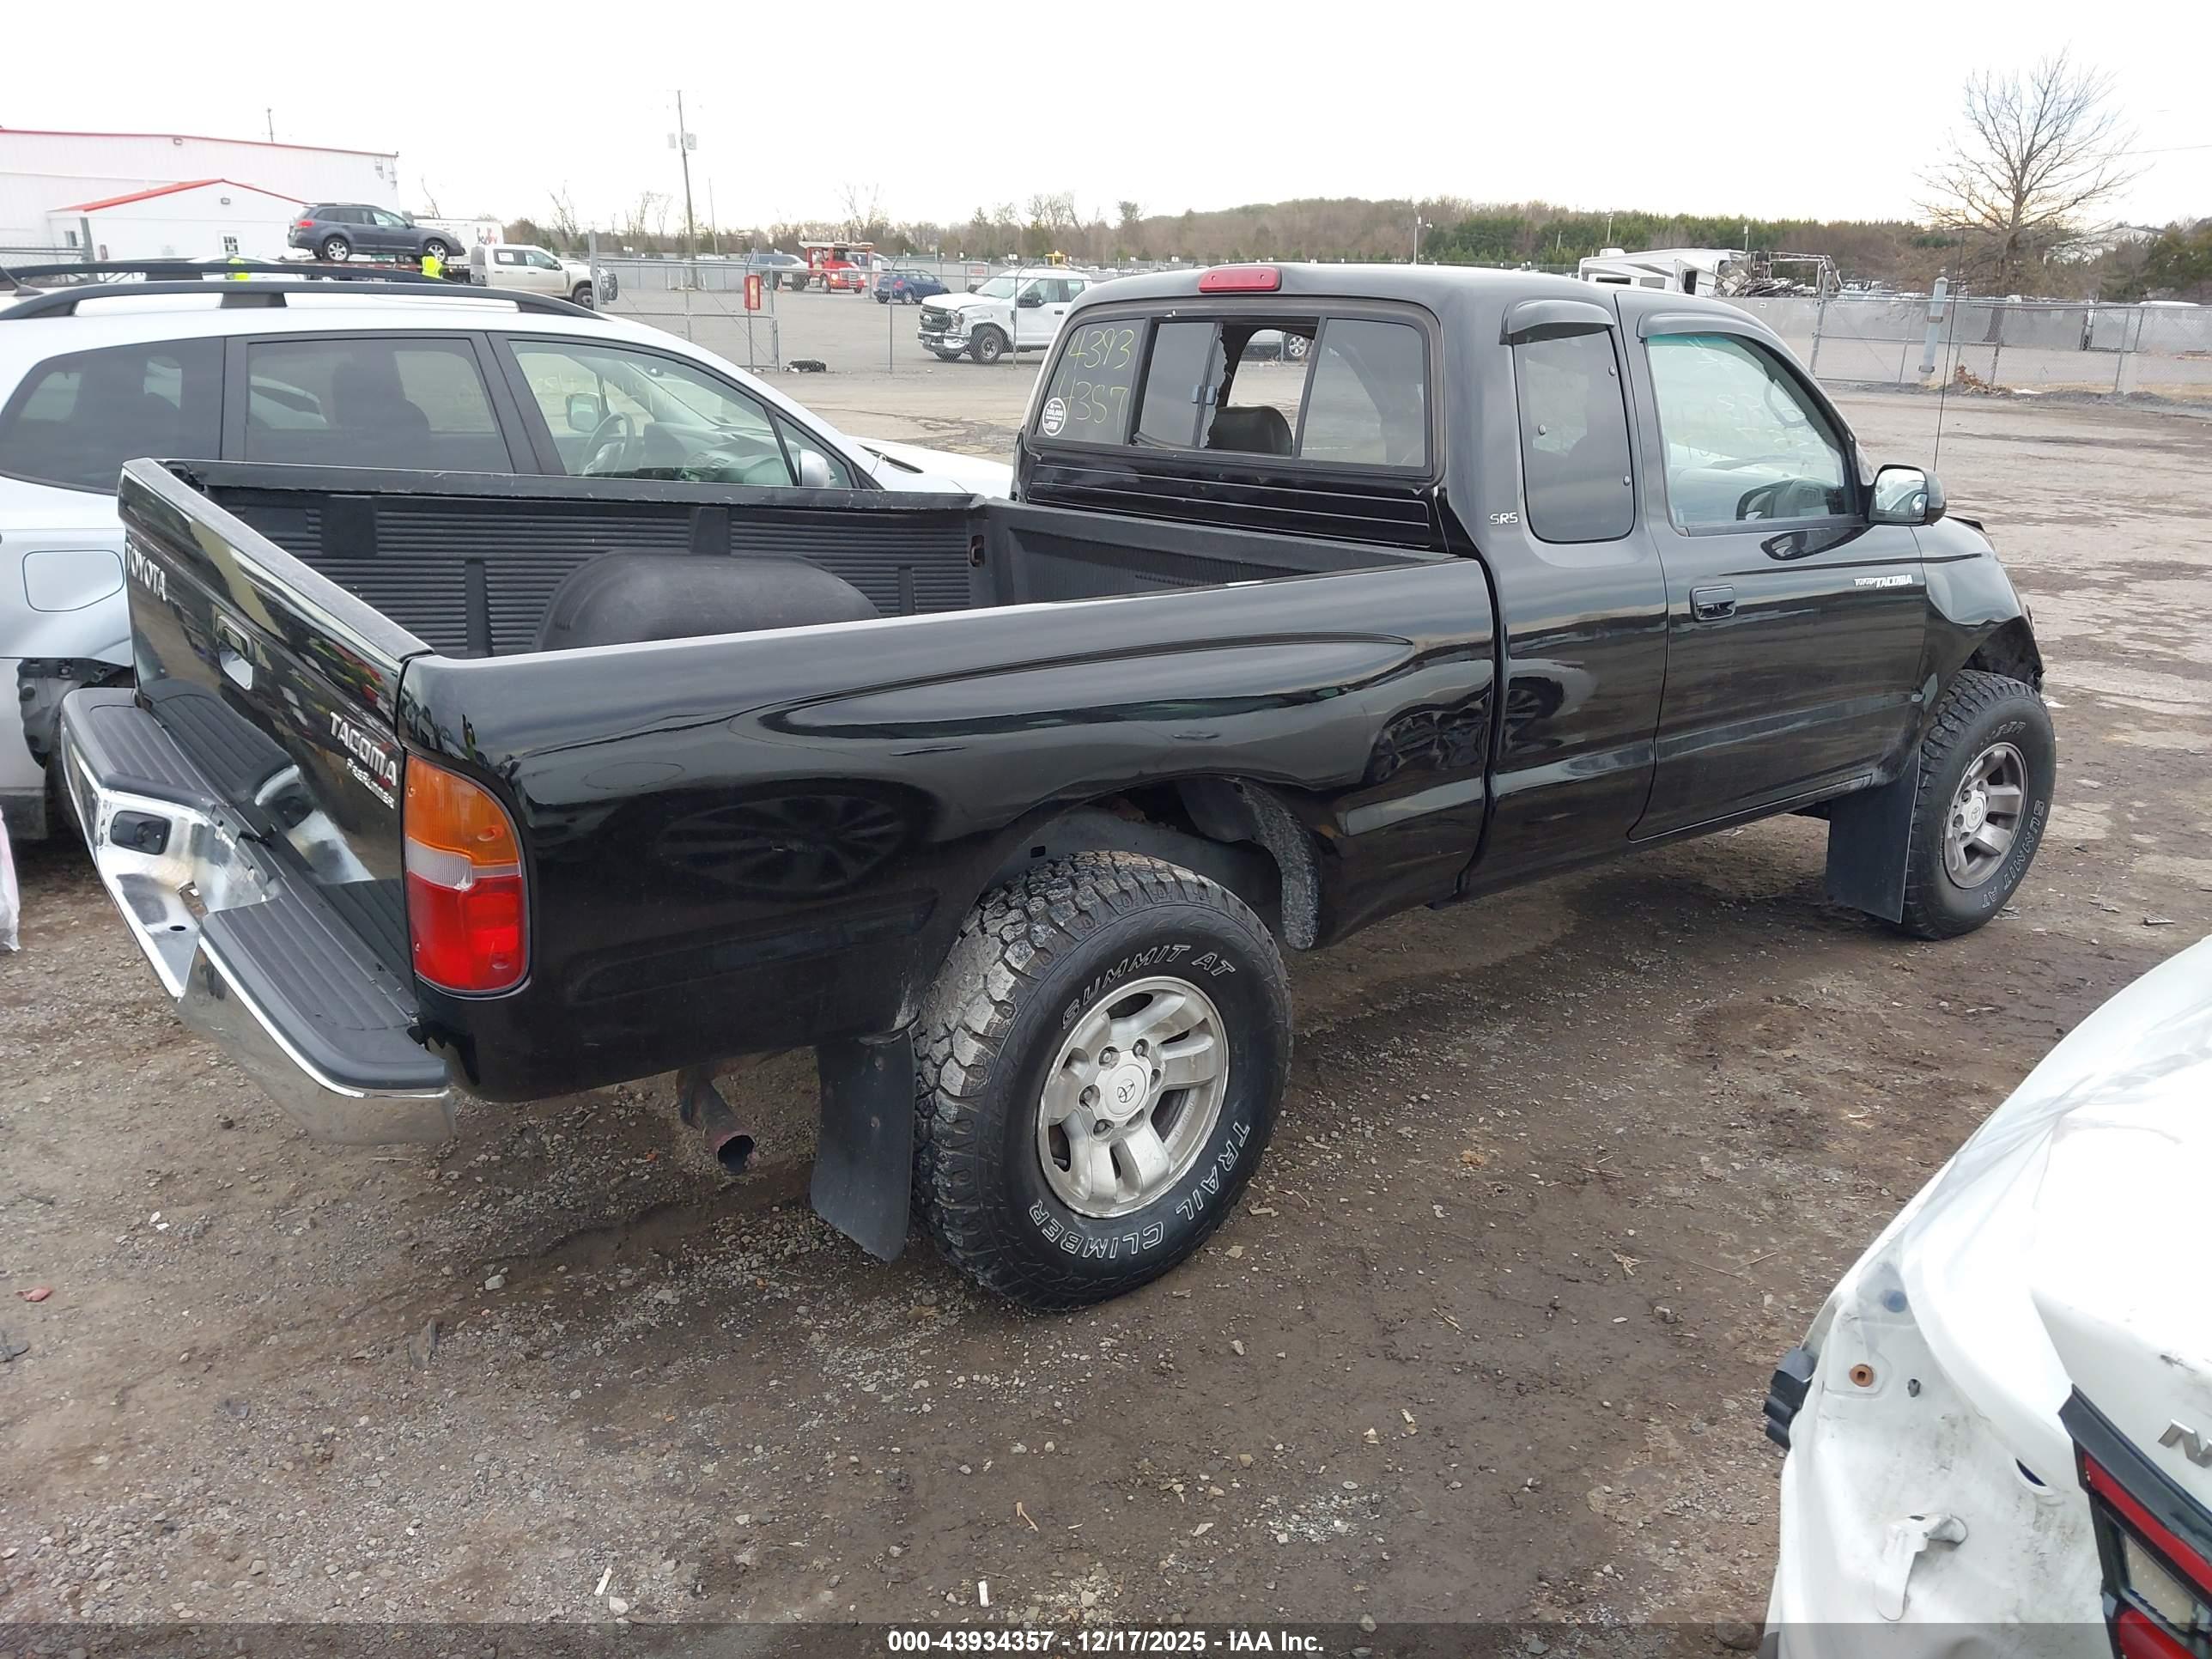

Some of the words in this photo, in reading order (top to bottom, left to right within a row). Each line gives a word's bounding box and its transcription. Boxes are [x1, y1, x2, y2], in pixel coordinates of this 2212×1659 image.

[1067, 328, 1134, 370] 4393
[1057, 371, 1129, 433] 4357
[1490, 512, 1518, 525] SR5
[125, 542, 167, 601] TOYOTA
[1875, 574, 1913, 588] TACOMA
[329, 711, 397, 786] TACOMA
[2003, 799, 2045, 890] SUMMIT
[1981, 885, 1997, 908] AT
[1062, 945, 1192, 1030] SUMMIT
[1191, 951, 1237, 976] AT
[1176, 1121, 1250, 1220] TRAIL
[1029, 1199, 1164, 1259] CLIMBER
